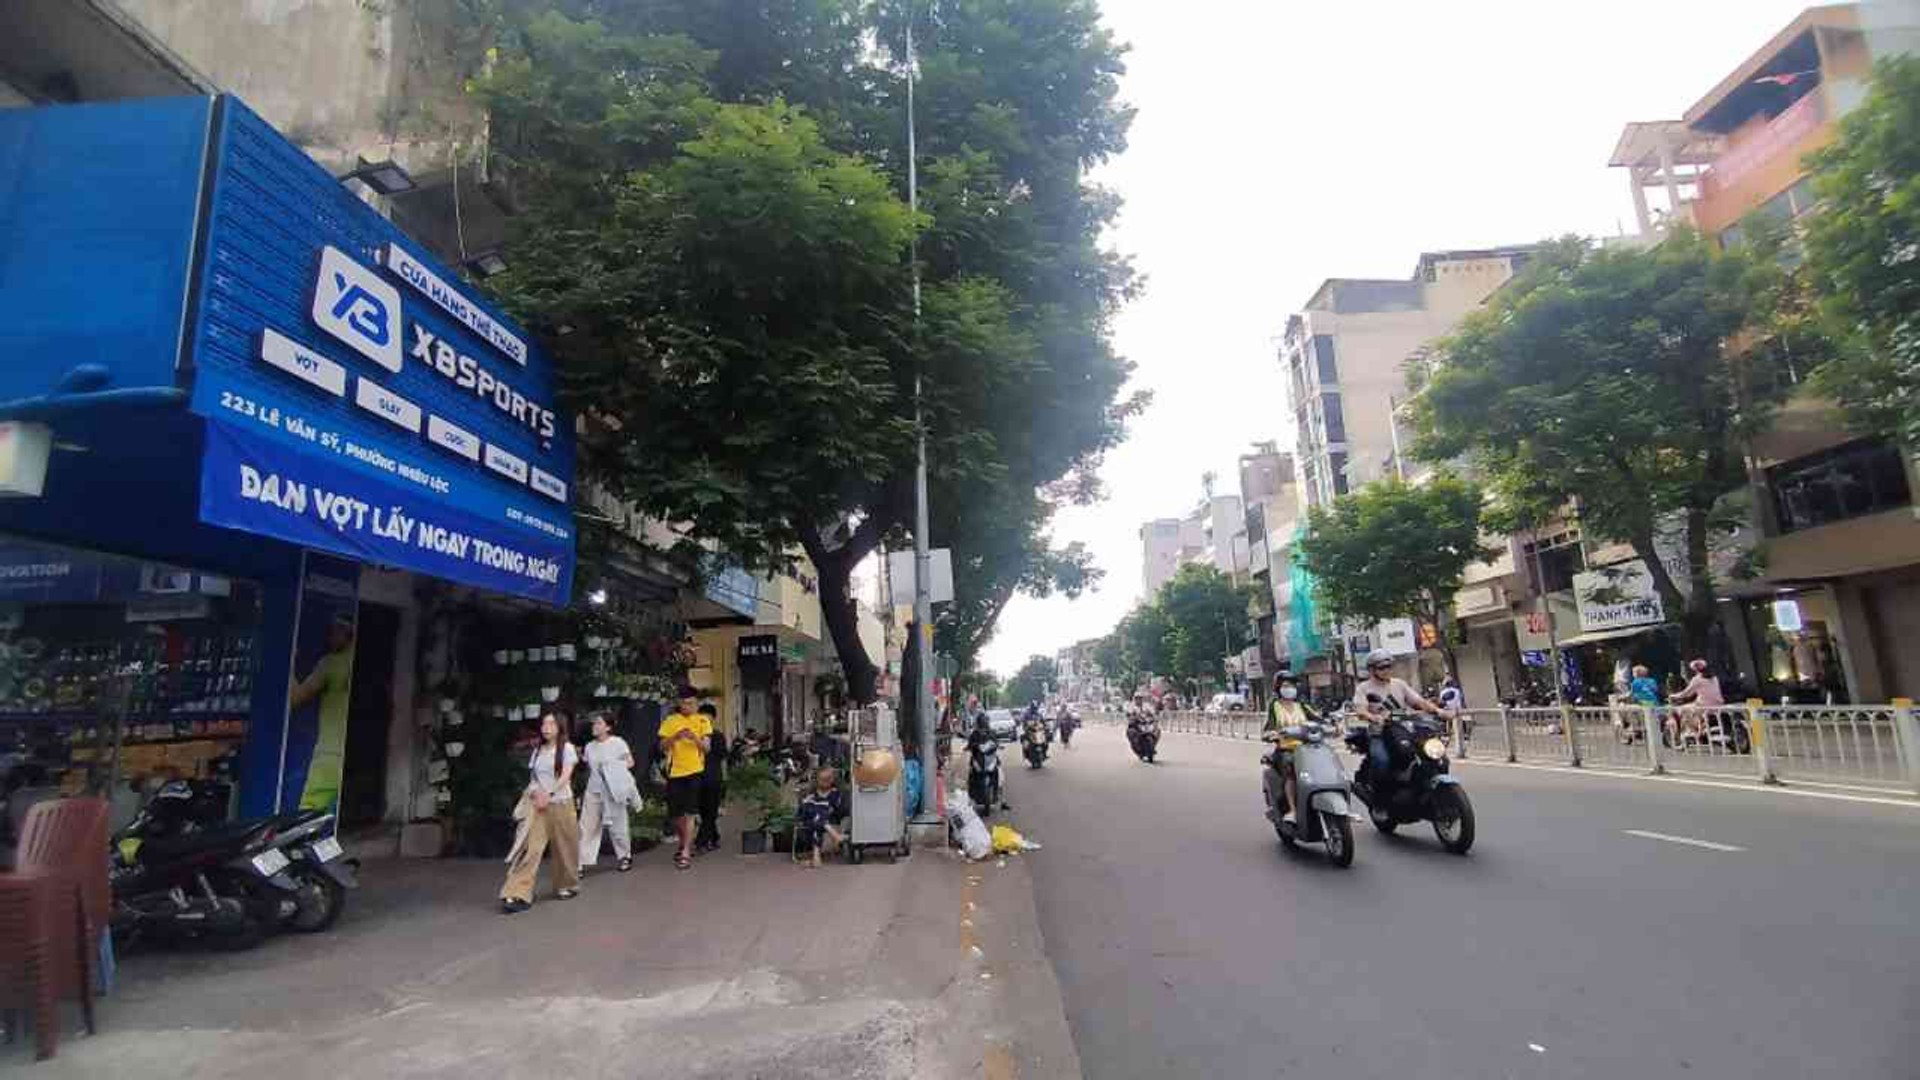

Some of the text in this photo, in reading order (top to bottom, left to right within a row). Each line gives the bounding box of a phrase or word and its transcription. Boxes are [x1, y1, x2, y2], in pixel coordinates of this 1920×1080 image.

[220, 391, 255, 416] 223
[258, 406, 280, 428] LÊ
[285, 415, 317, 441] VĂN
[411, 323, 556, 437] XBSPORTS
[312, 487, 370, 532] VỢT
[371, 505, 415, 544] LẤY
[417, 521, 470, 559] NGAY
[471, 539, 525, 575] TRONG
